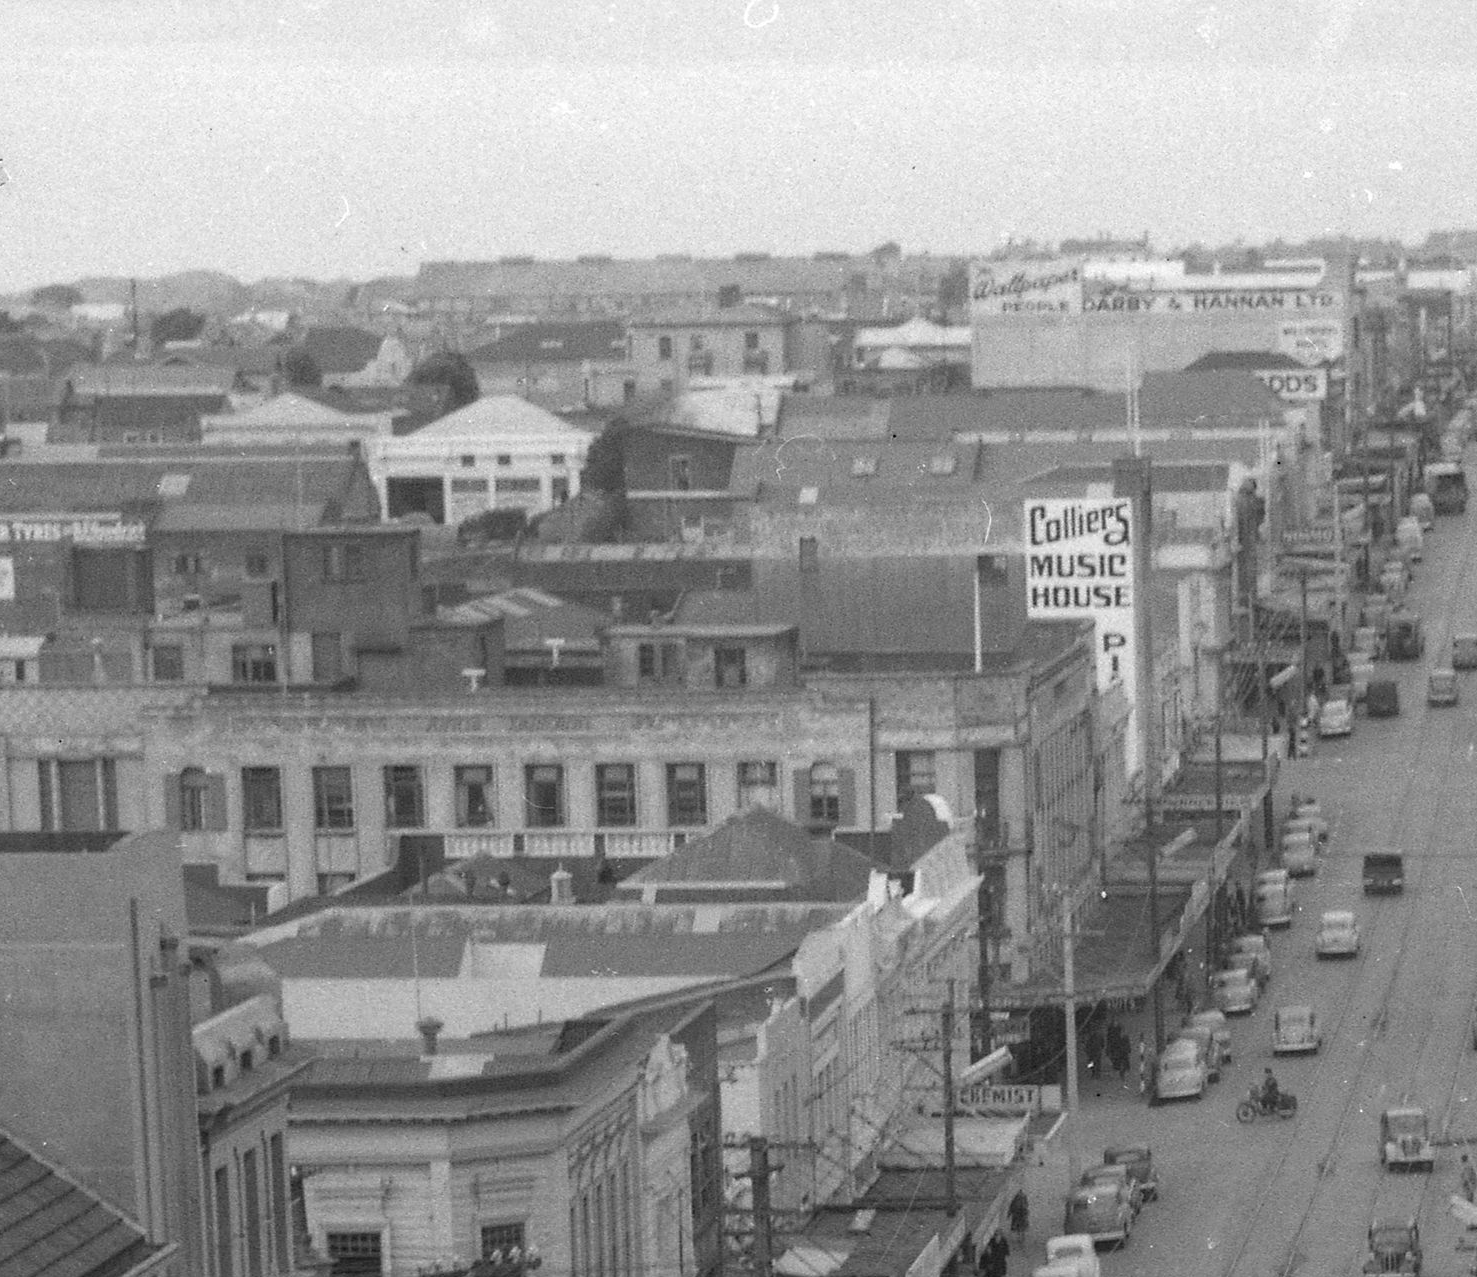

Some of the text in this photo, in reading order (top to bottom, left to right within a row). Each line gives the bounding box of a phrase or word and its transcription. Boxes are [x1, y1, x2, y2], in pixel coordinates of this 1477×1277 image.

[1082, 294, 1156, 312] DARBY
[1193, 293, 1284, 310] HANNAN
[1029, 554, 1126, 578] MUSIC
[1031, 585, 1132, 609] HOUSE
